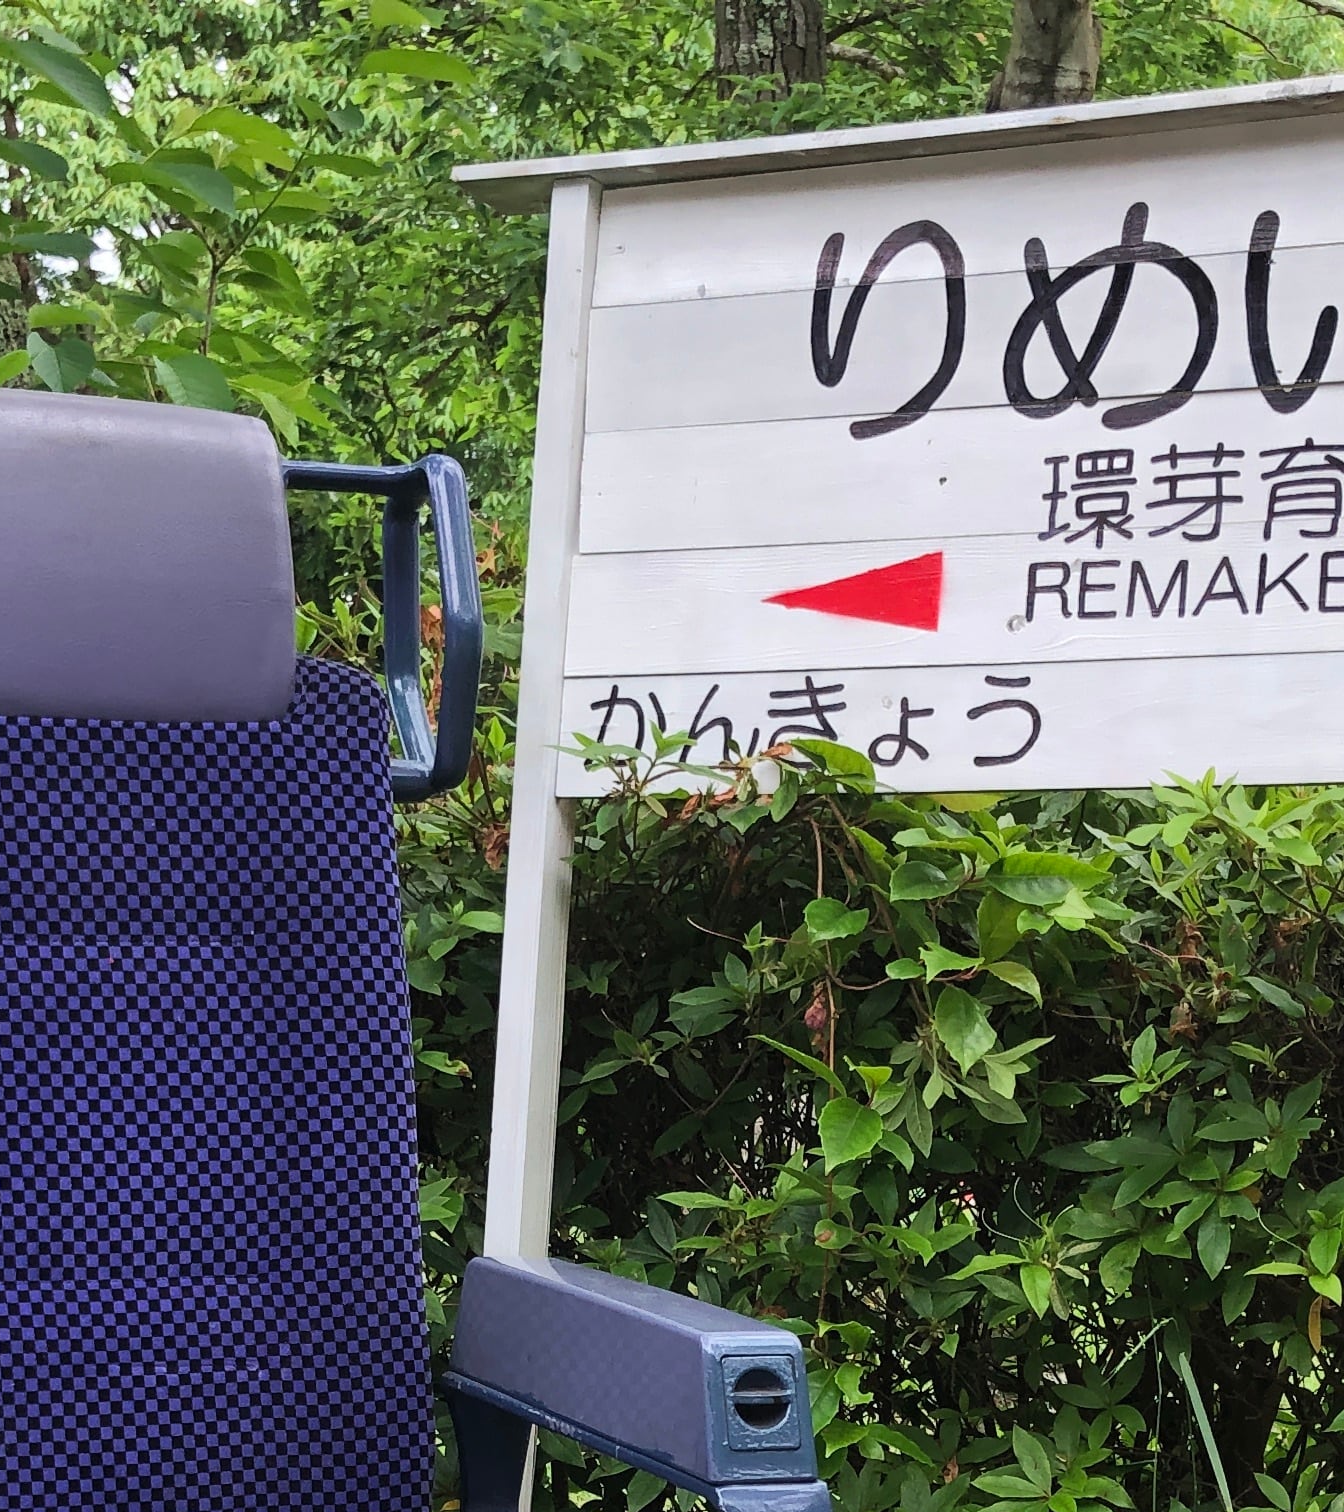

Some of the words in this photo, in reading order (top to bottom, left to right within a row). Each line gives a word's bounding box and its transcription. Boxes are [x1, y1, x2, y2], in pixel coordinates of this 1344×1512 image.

[589, 675, 1043, 771] かんきょう
